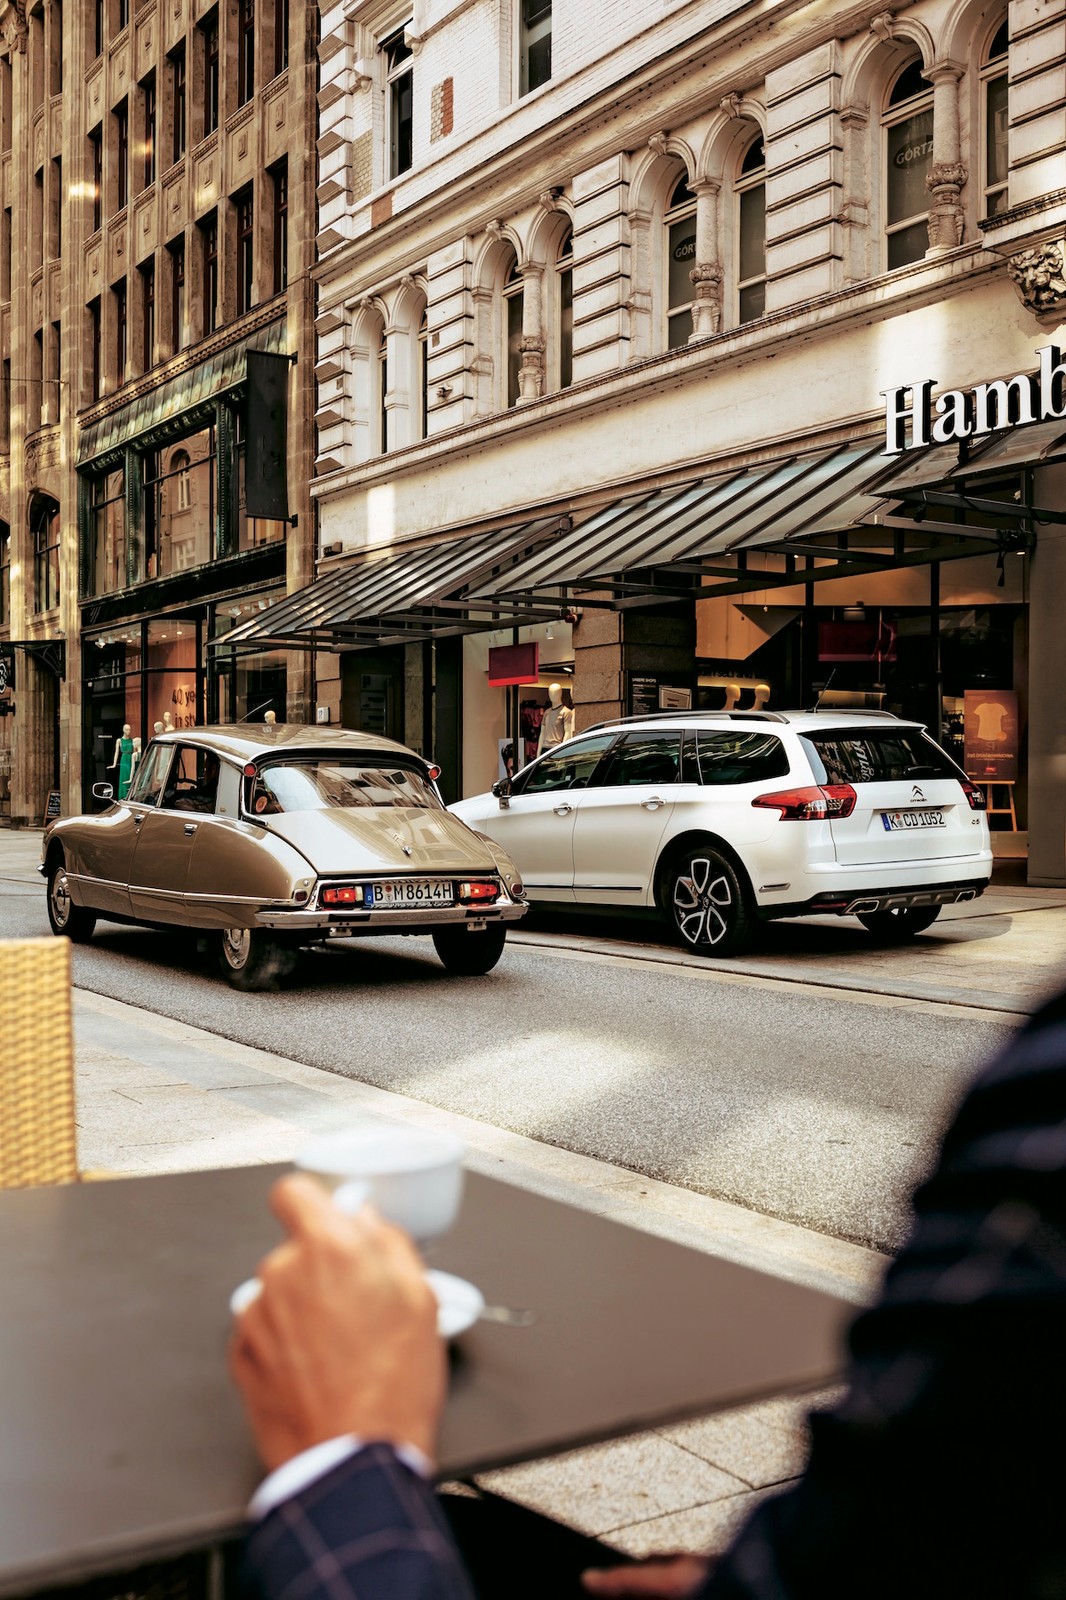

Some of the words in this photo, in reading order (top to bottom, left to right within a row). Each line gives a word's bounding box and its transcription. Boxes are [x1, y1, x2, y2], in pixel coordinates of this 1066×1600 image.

[172, 688, 183, 706] 40
[175, 713, 183, 728] in
[374, 886, 384, 901] B
